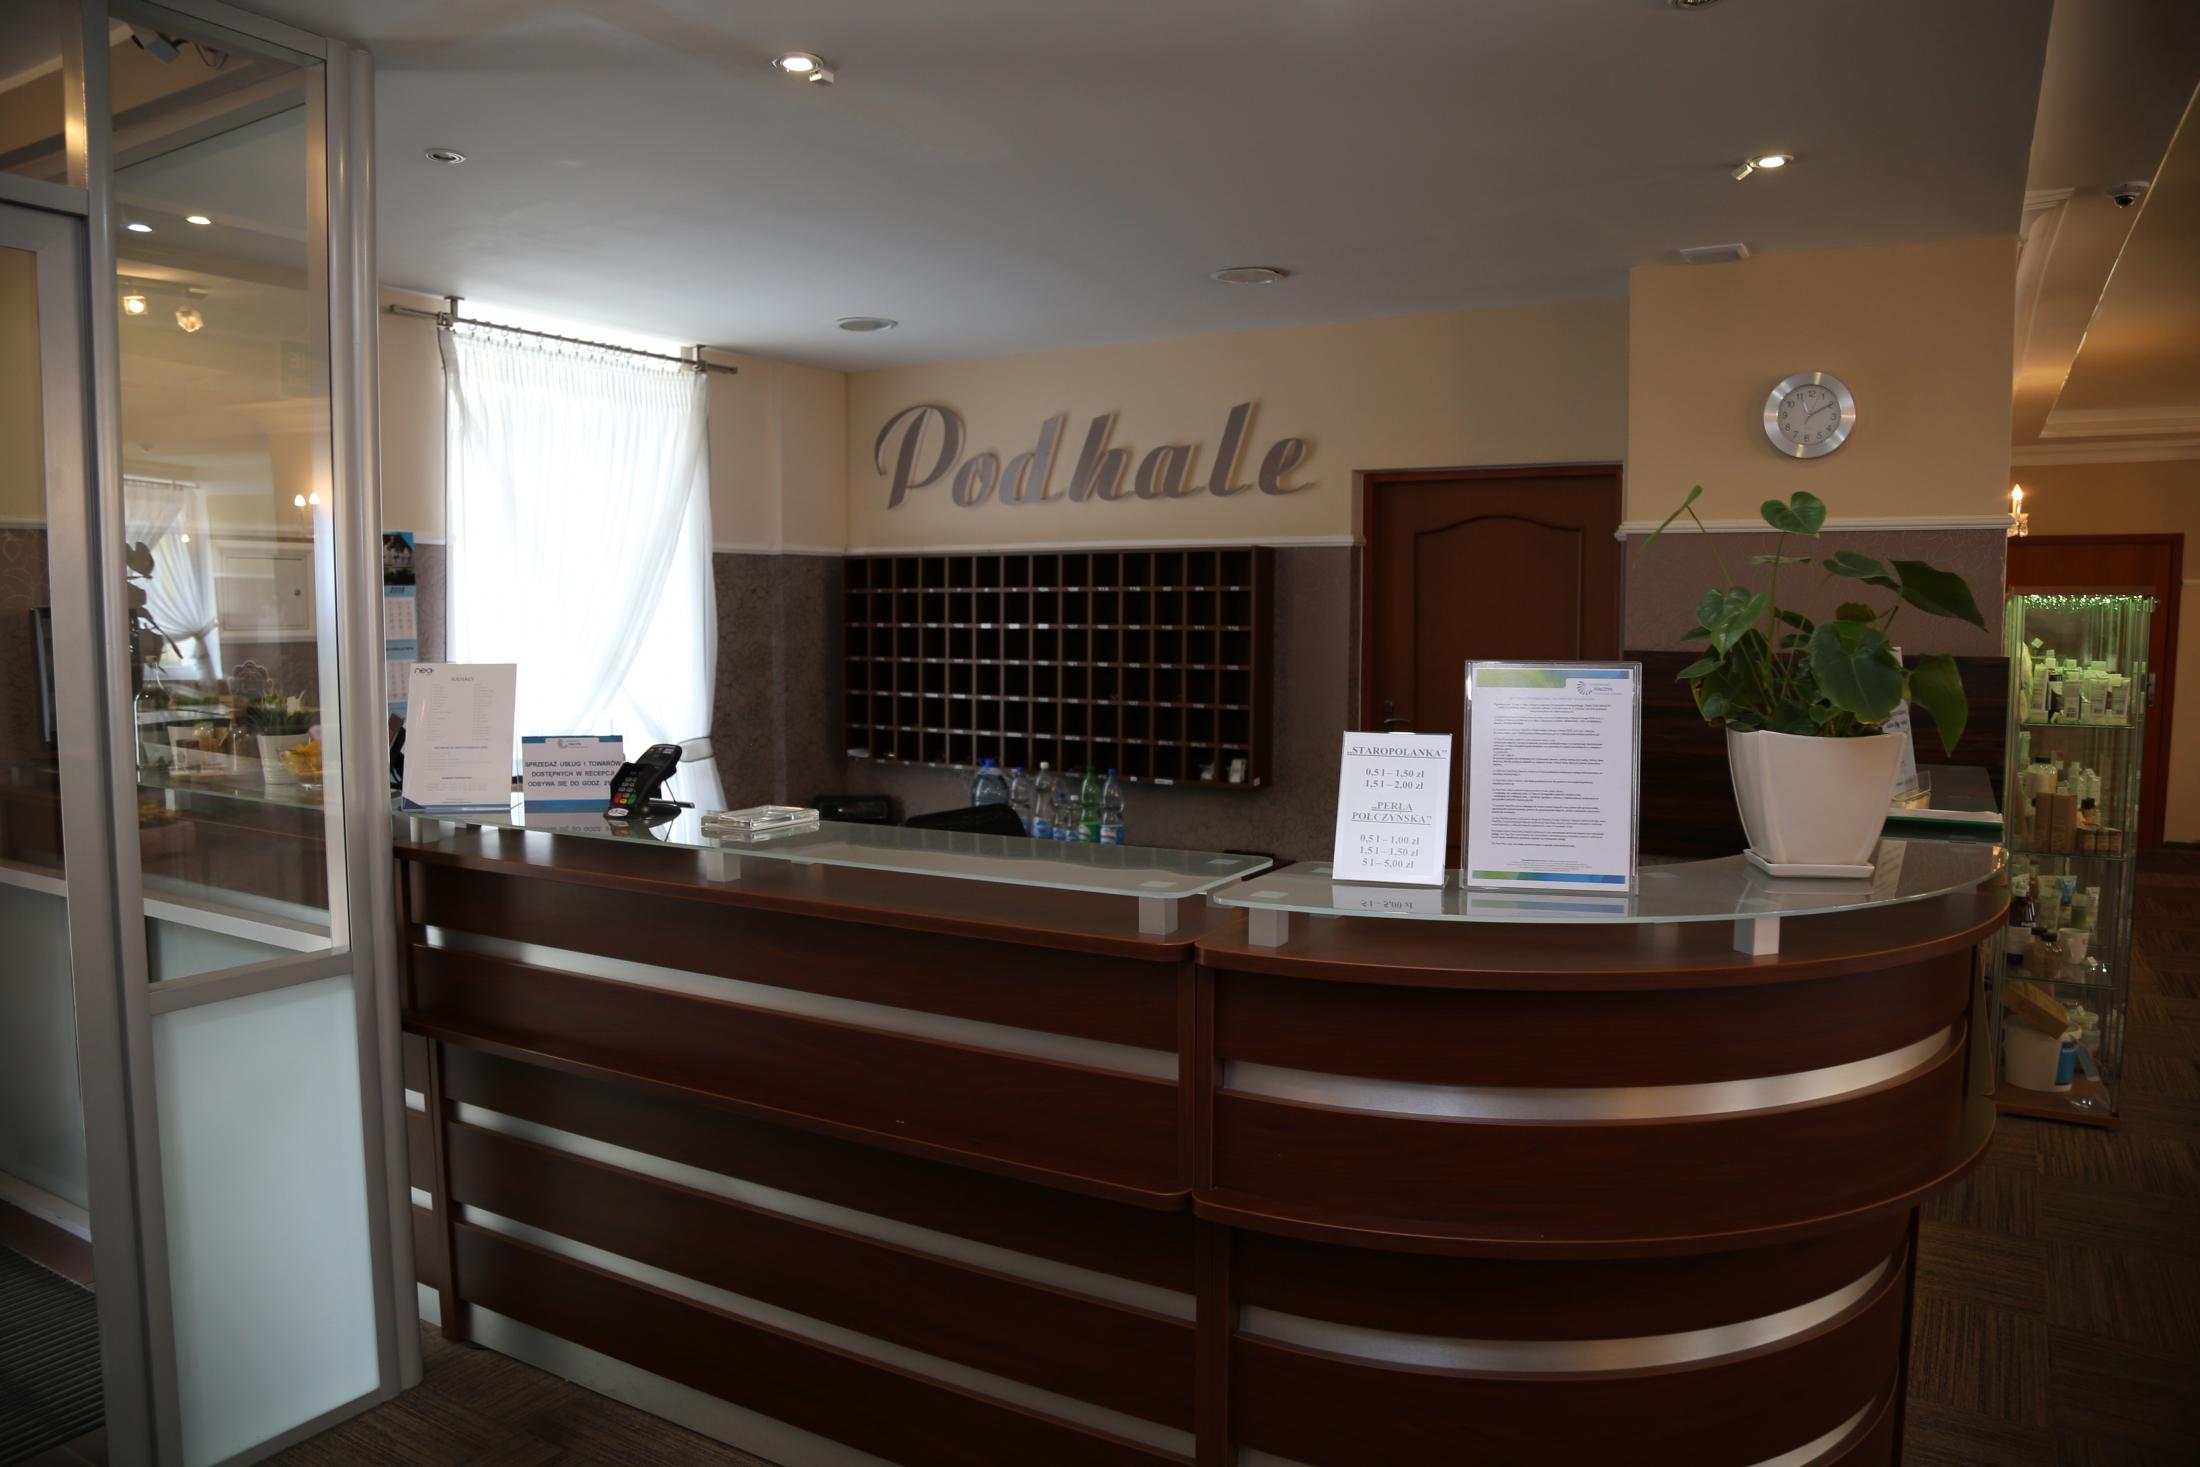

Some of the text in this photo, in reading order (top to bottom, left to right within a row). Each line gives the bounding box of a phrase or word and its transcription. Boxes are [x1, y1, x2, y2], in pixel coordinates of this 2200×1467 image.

[1808, 390, 1816, 398] 12
[1787, 400, 1795, 408] 10
[1782, 411, 1788, 419] 9
[1831, 413, 1836, 421] 3
[1785, 423, 1791, 431] 8
[1826, 424, 1831, 432] 4
[1804, 434, 1809, 442] 6
[1817, 431, 1822, 440] 5
[874, 401, 1316, 510] Podhale
[1365, 768, 1379, 777] 0,5
[1396, 769, 1414, 778] 1,50
[1365, 779, 1379, 788] 1,5
[1394, 780, 1413, 789] 2,00
[1360, 834, 1374, 843] 0,5
[1391, 835, 1409, 845] 1,00
[1359, 846, 1373, 855] 1,5
[1390, 847, 1408, 857] 1,50
[1362, 857, 1368, 866] 5
[1384, 859, 1403, 868] 5,00
